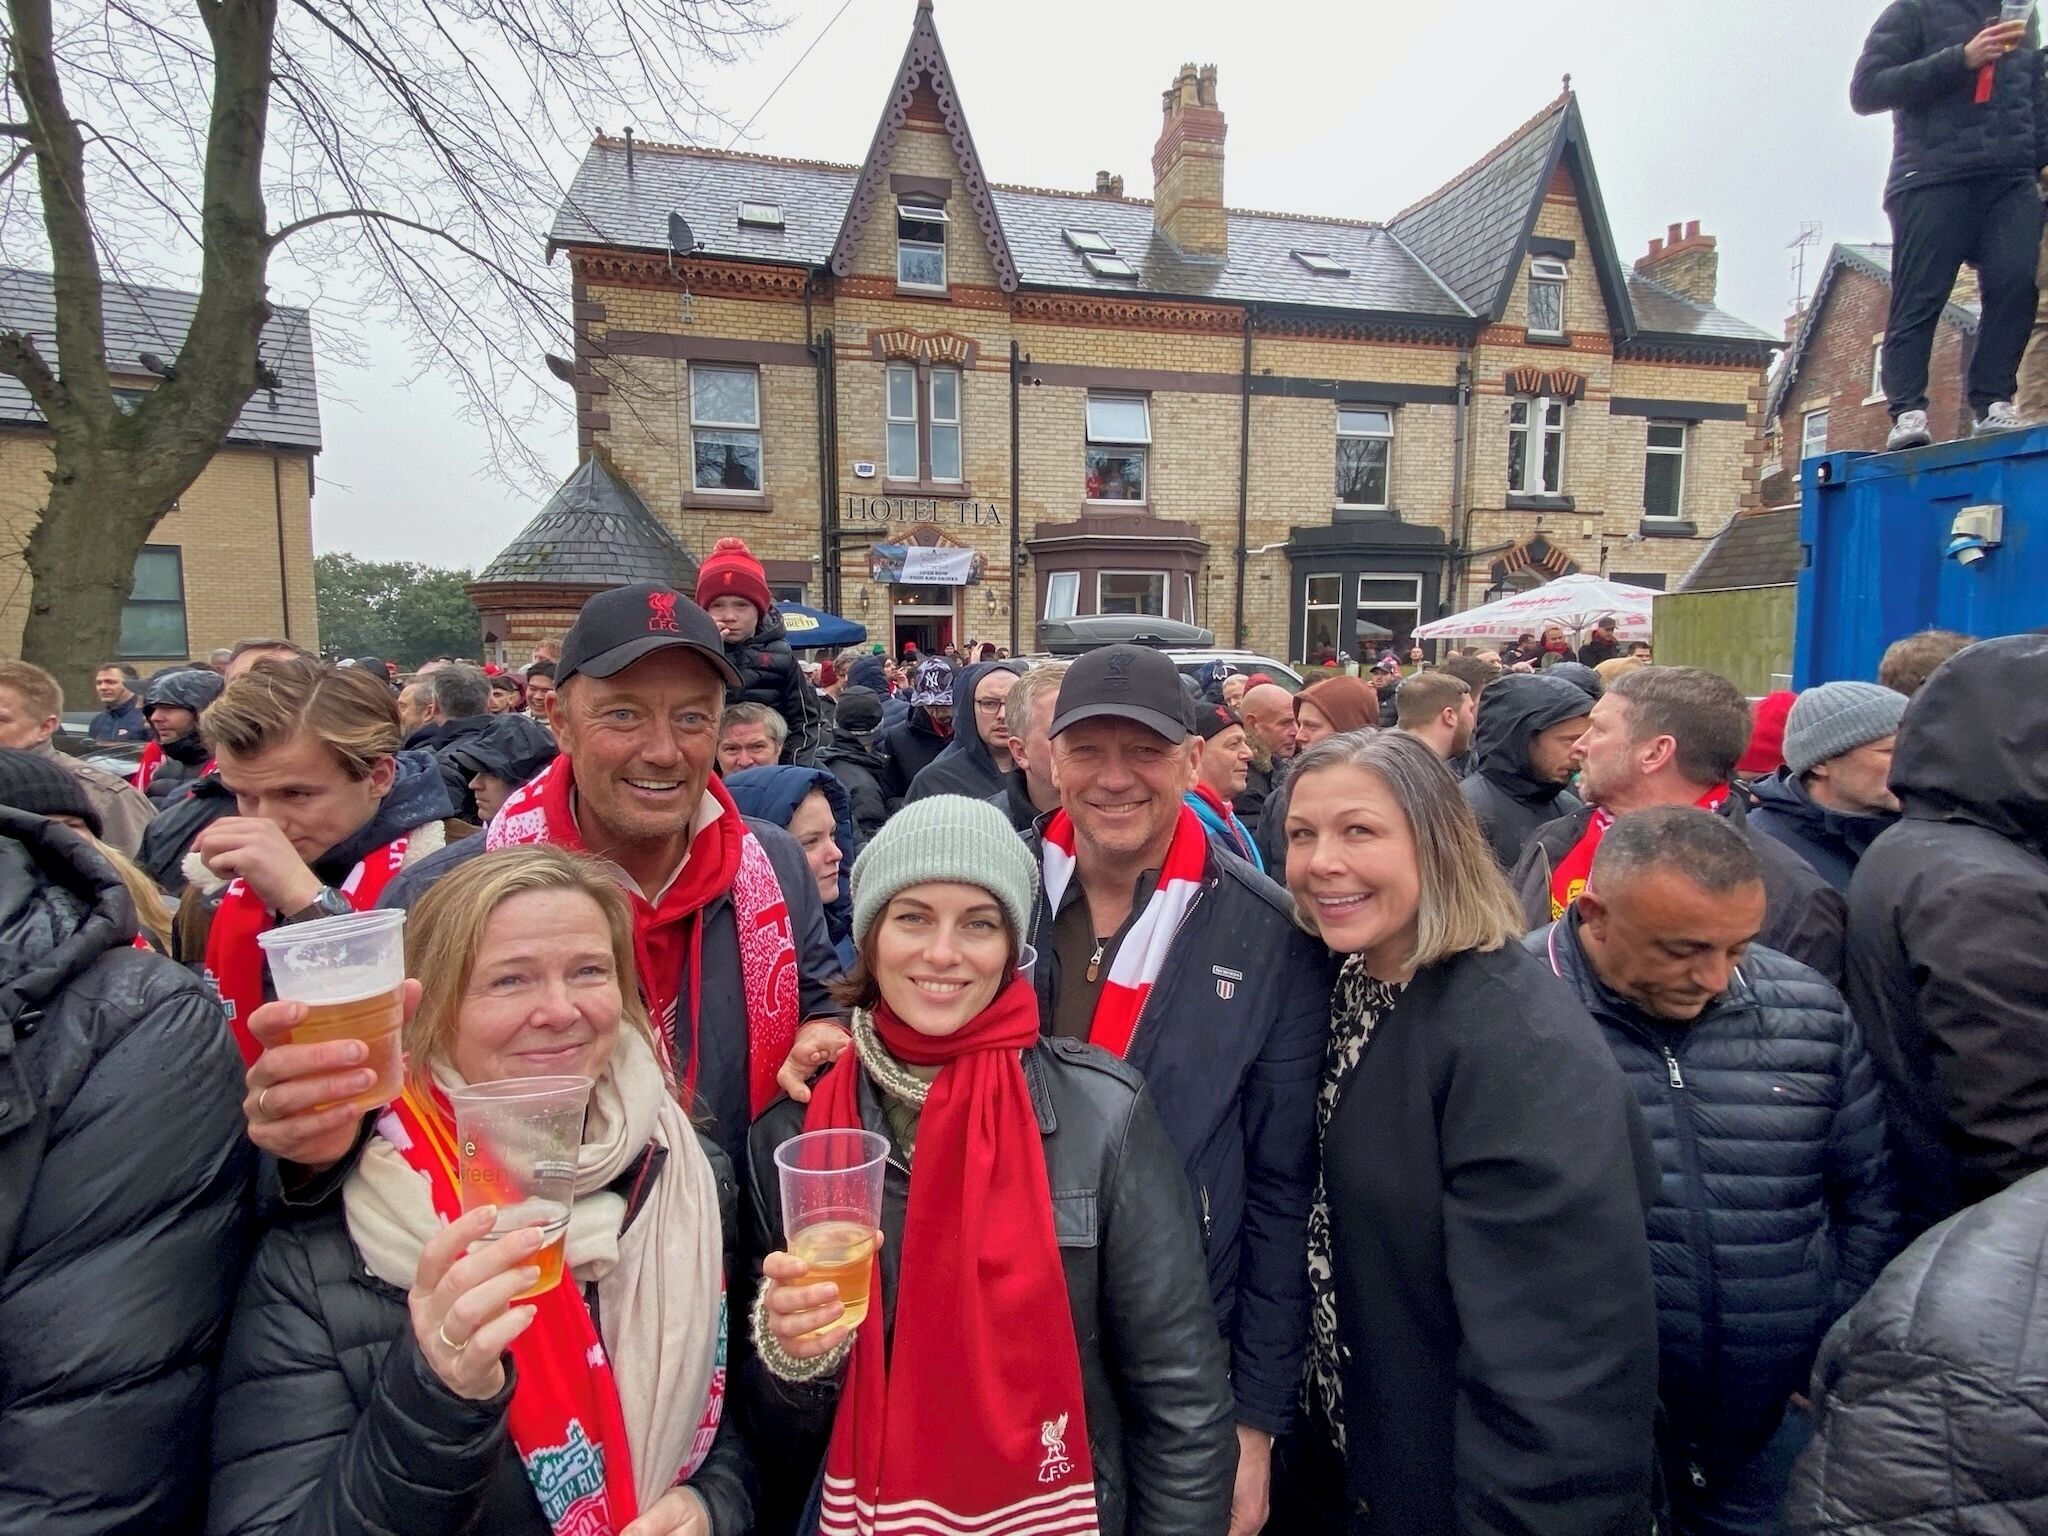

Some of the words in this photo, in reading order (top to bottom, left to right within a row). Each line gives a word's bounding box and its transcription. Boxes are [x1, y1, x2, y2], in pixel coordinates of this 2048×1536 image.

[847, 496, 947, 522] HOTEL
[953, 500, 1002, 525] TIA
[461, 1165, 508, 1183] reen
